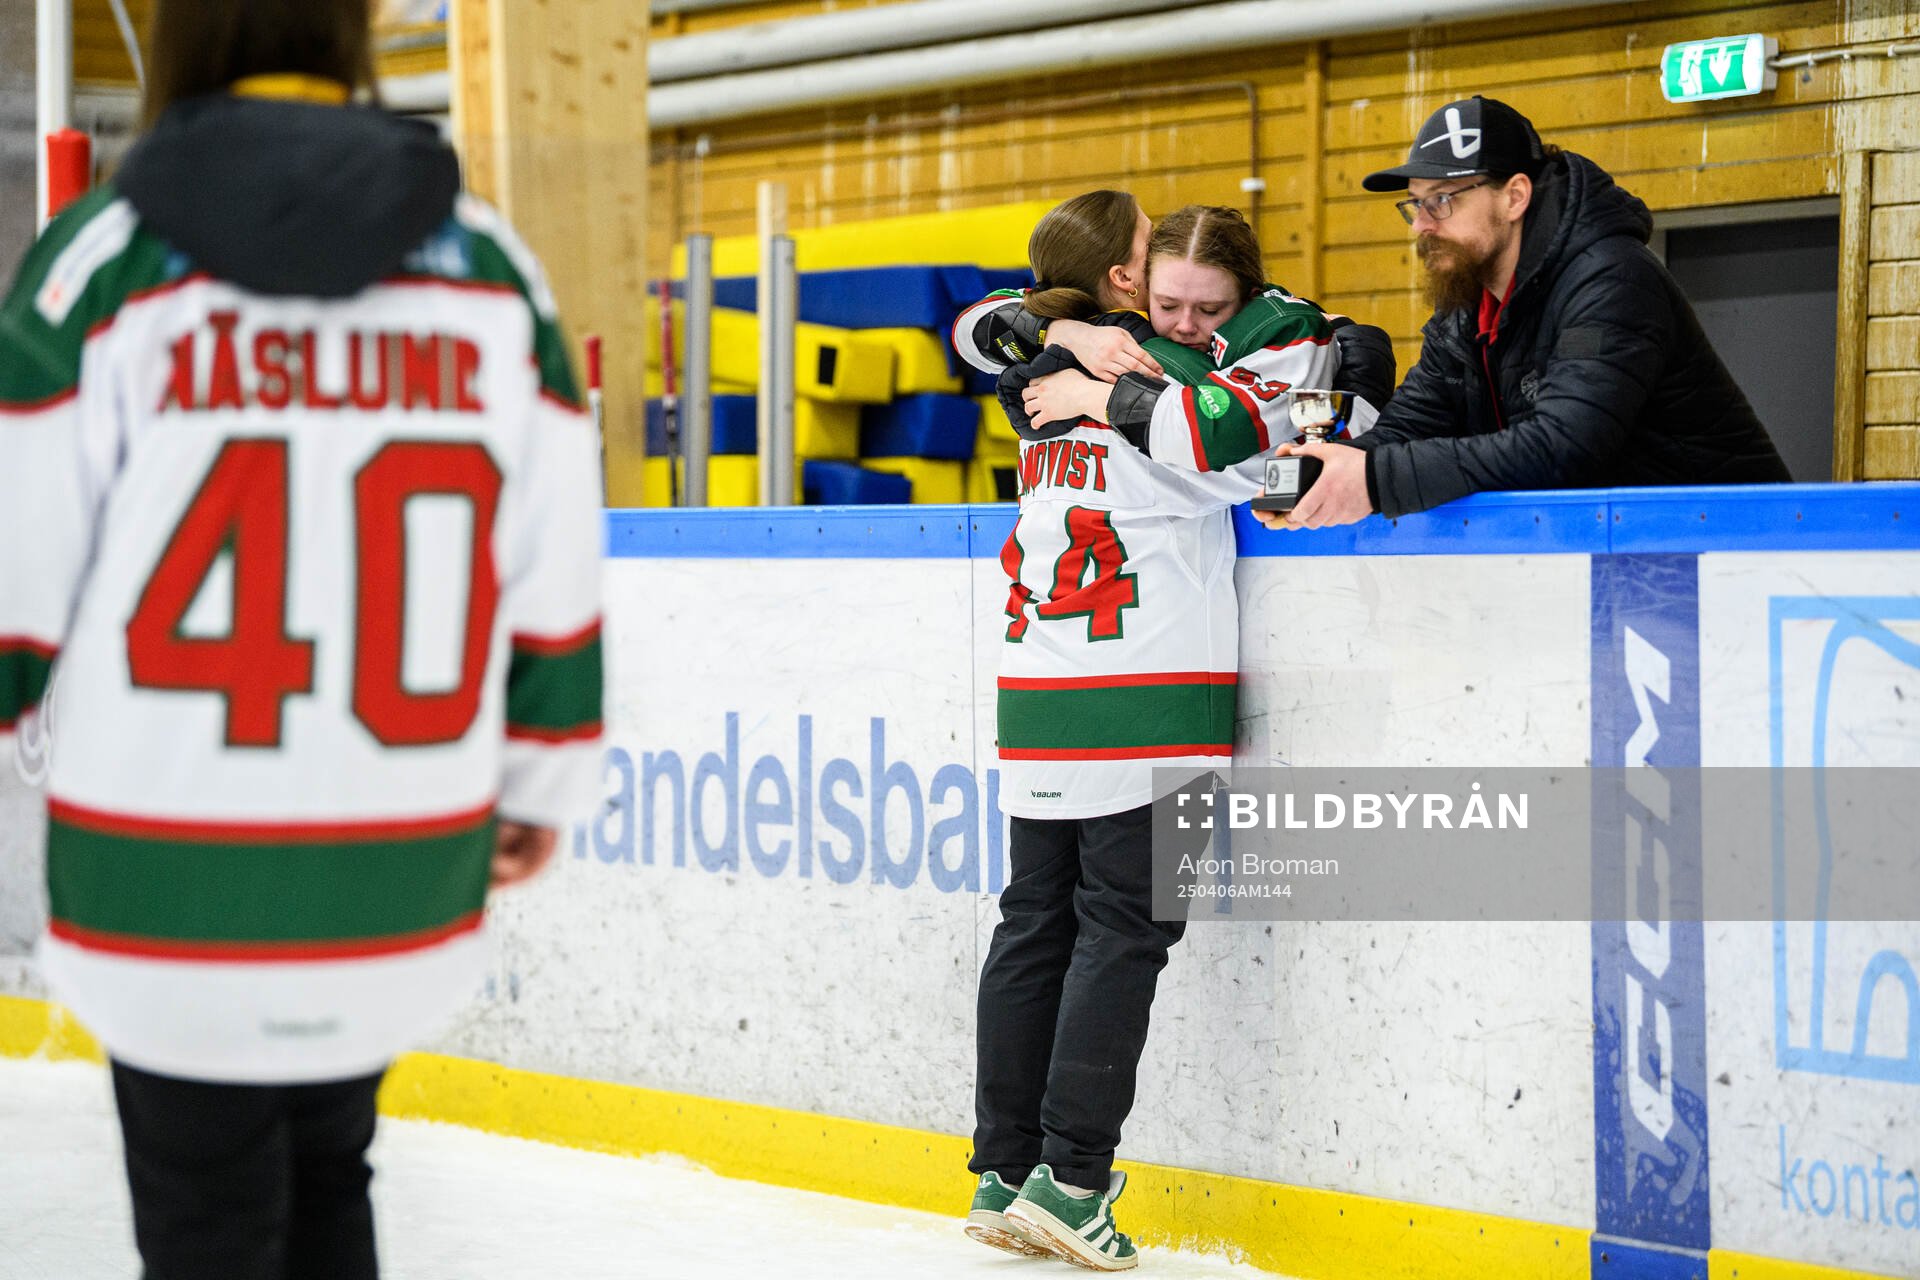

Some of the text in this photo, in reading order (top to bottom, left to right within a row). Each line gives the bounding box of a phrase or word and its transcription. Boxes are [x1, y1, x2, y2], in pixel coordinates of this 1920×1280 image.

[126, 437, 504, 748] 40
[573, 711, 1004, 895] andelsba
[1623, 625, 1674, 1142] CCM
[1778, 1124, 1920, 1230] konta
